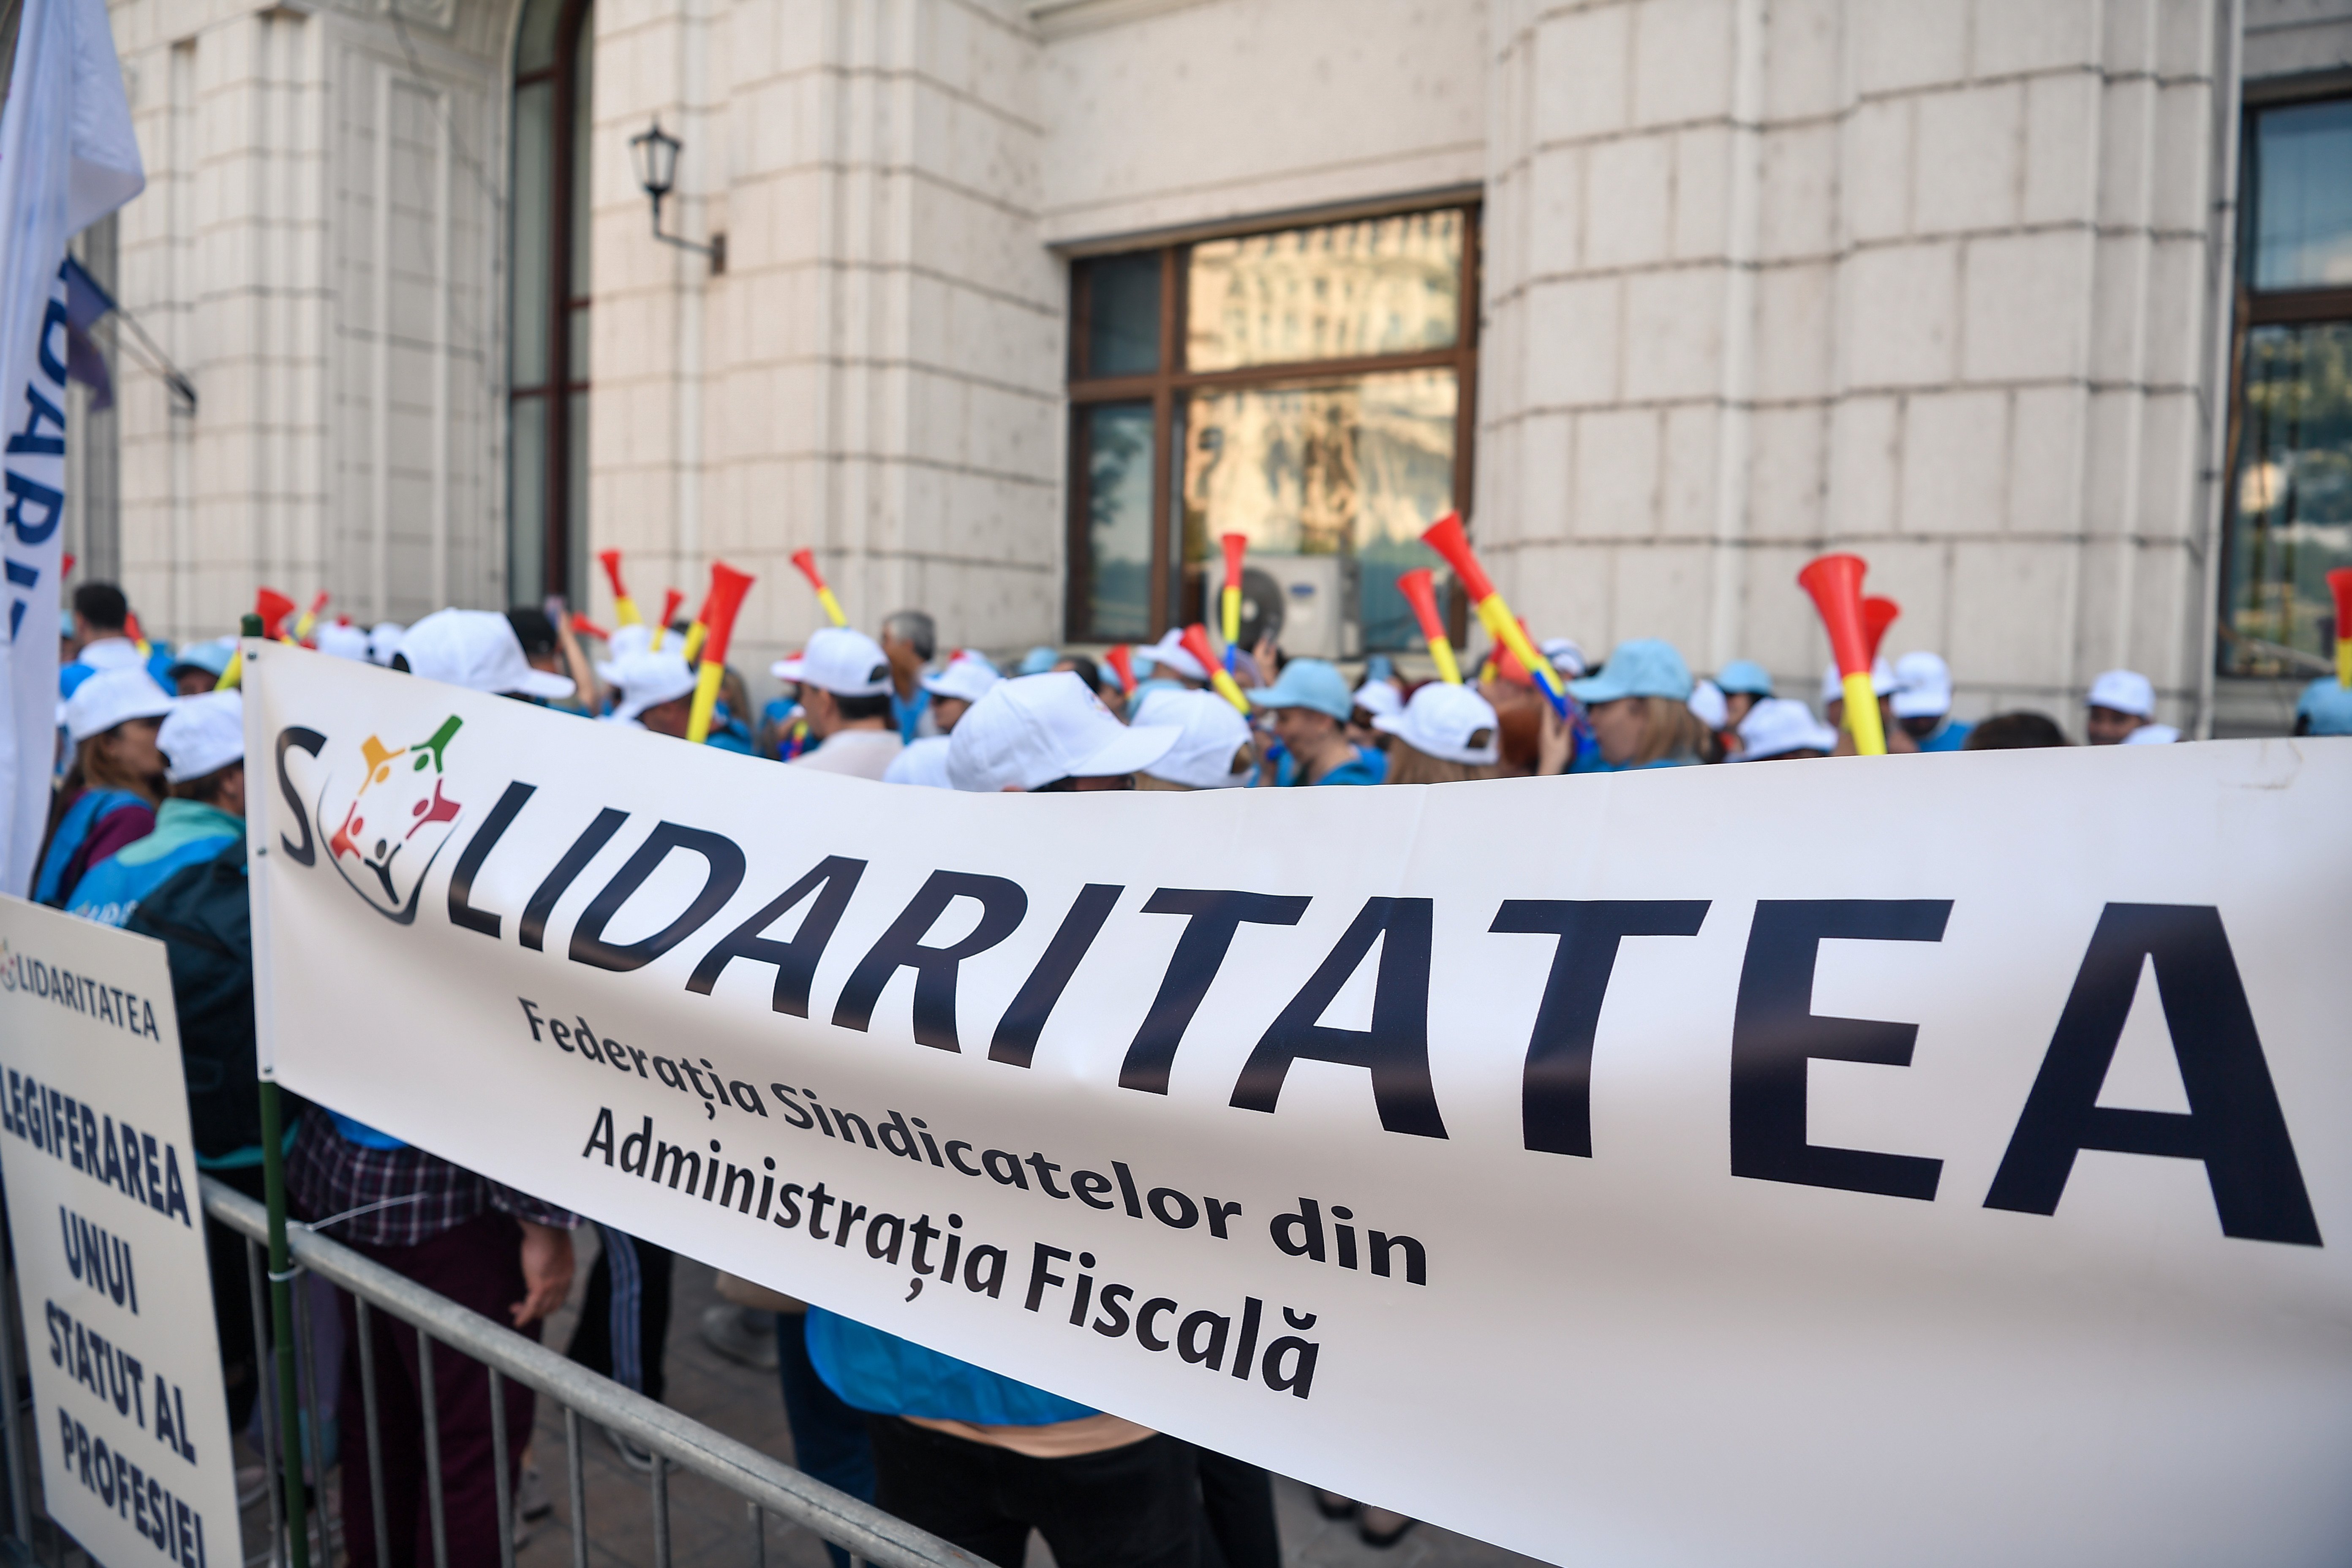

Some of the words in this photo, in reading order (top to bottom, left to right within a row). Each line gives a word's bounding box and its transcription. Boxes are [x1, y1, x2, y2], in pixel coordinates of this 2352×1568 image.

[0, 1062, 192, 1228] LEGIFERAREA
[518, 997, 769, 1121] Federația
[770, 1082, 1243, 1240] Sindicatelor
[1269, 1196, 1427, 1287] din
[59, 1205, 139, 1316] UNUI
[582, 1107, 1008, 1303] Administrația
[1024, 1241, 1320, 1400] Fiscală
[44, 1298, 146, 1430] STATUT
[154, 1373, 197, 1467] AL
[57, 1405, 207, 1568] PROFESIEI
